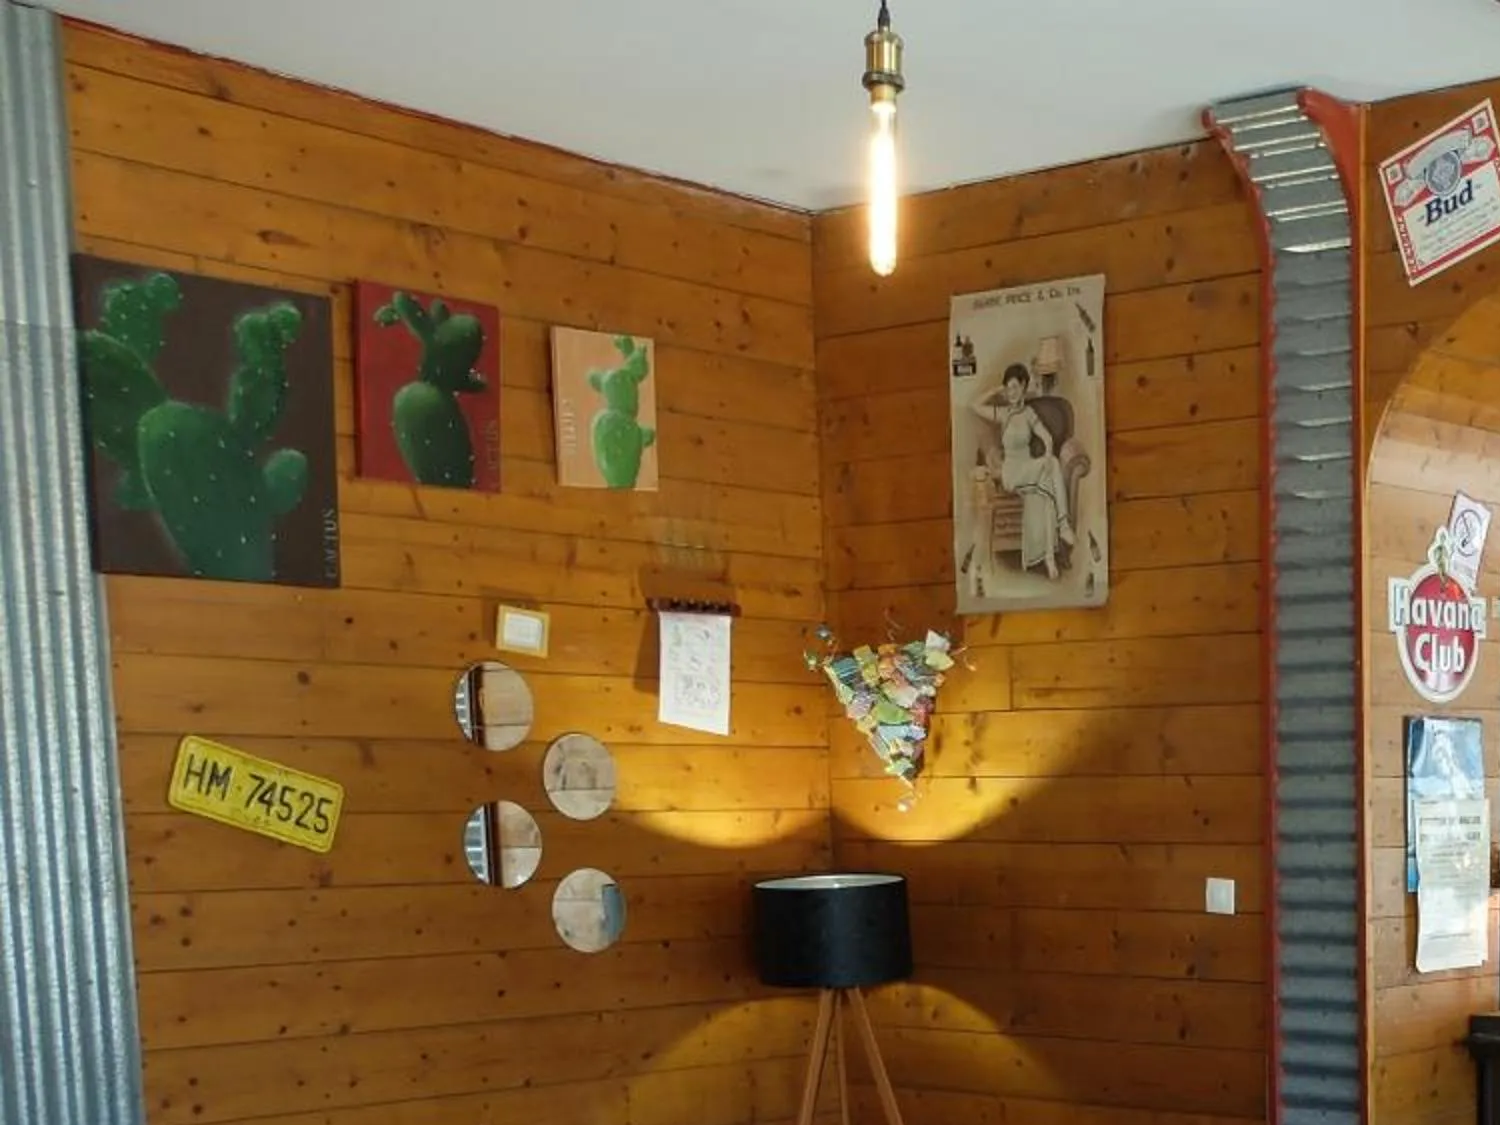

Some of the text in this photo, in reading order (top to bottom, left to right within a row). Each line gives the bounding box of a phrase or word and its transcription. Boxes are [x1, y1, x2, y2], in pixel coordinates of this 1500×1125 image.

[1425, 180, 1474, 227] Bud
[1394, 583, 1485, 633] Havana
[1415, 633, 1466, 674] Club
[183, 753, 333, 834] HM 74525
